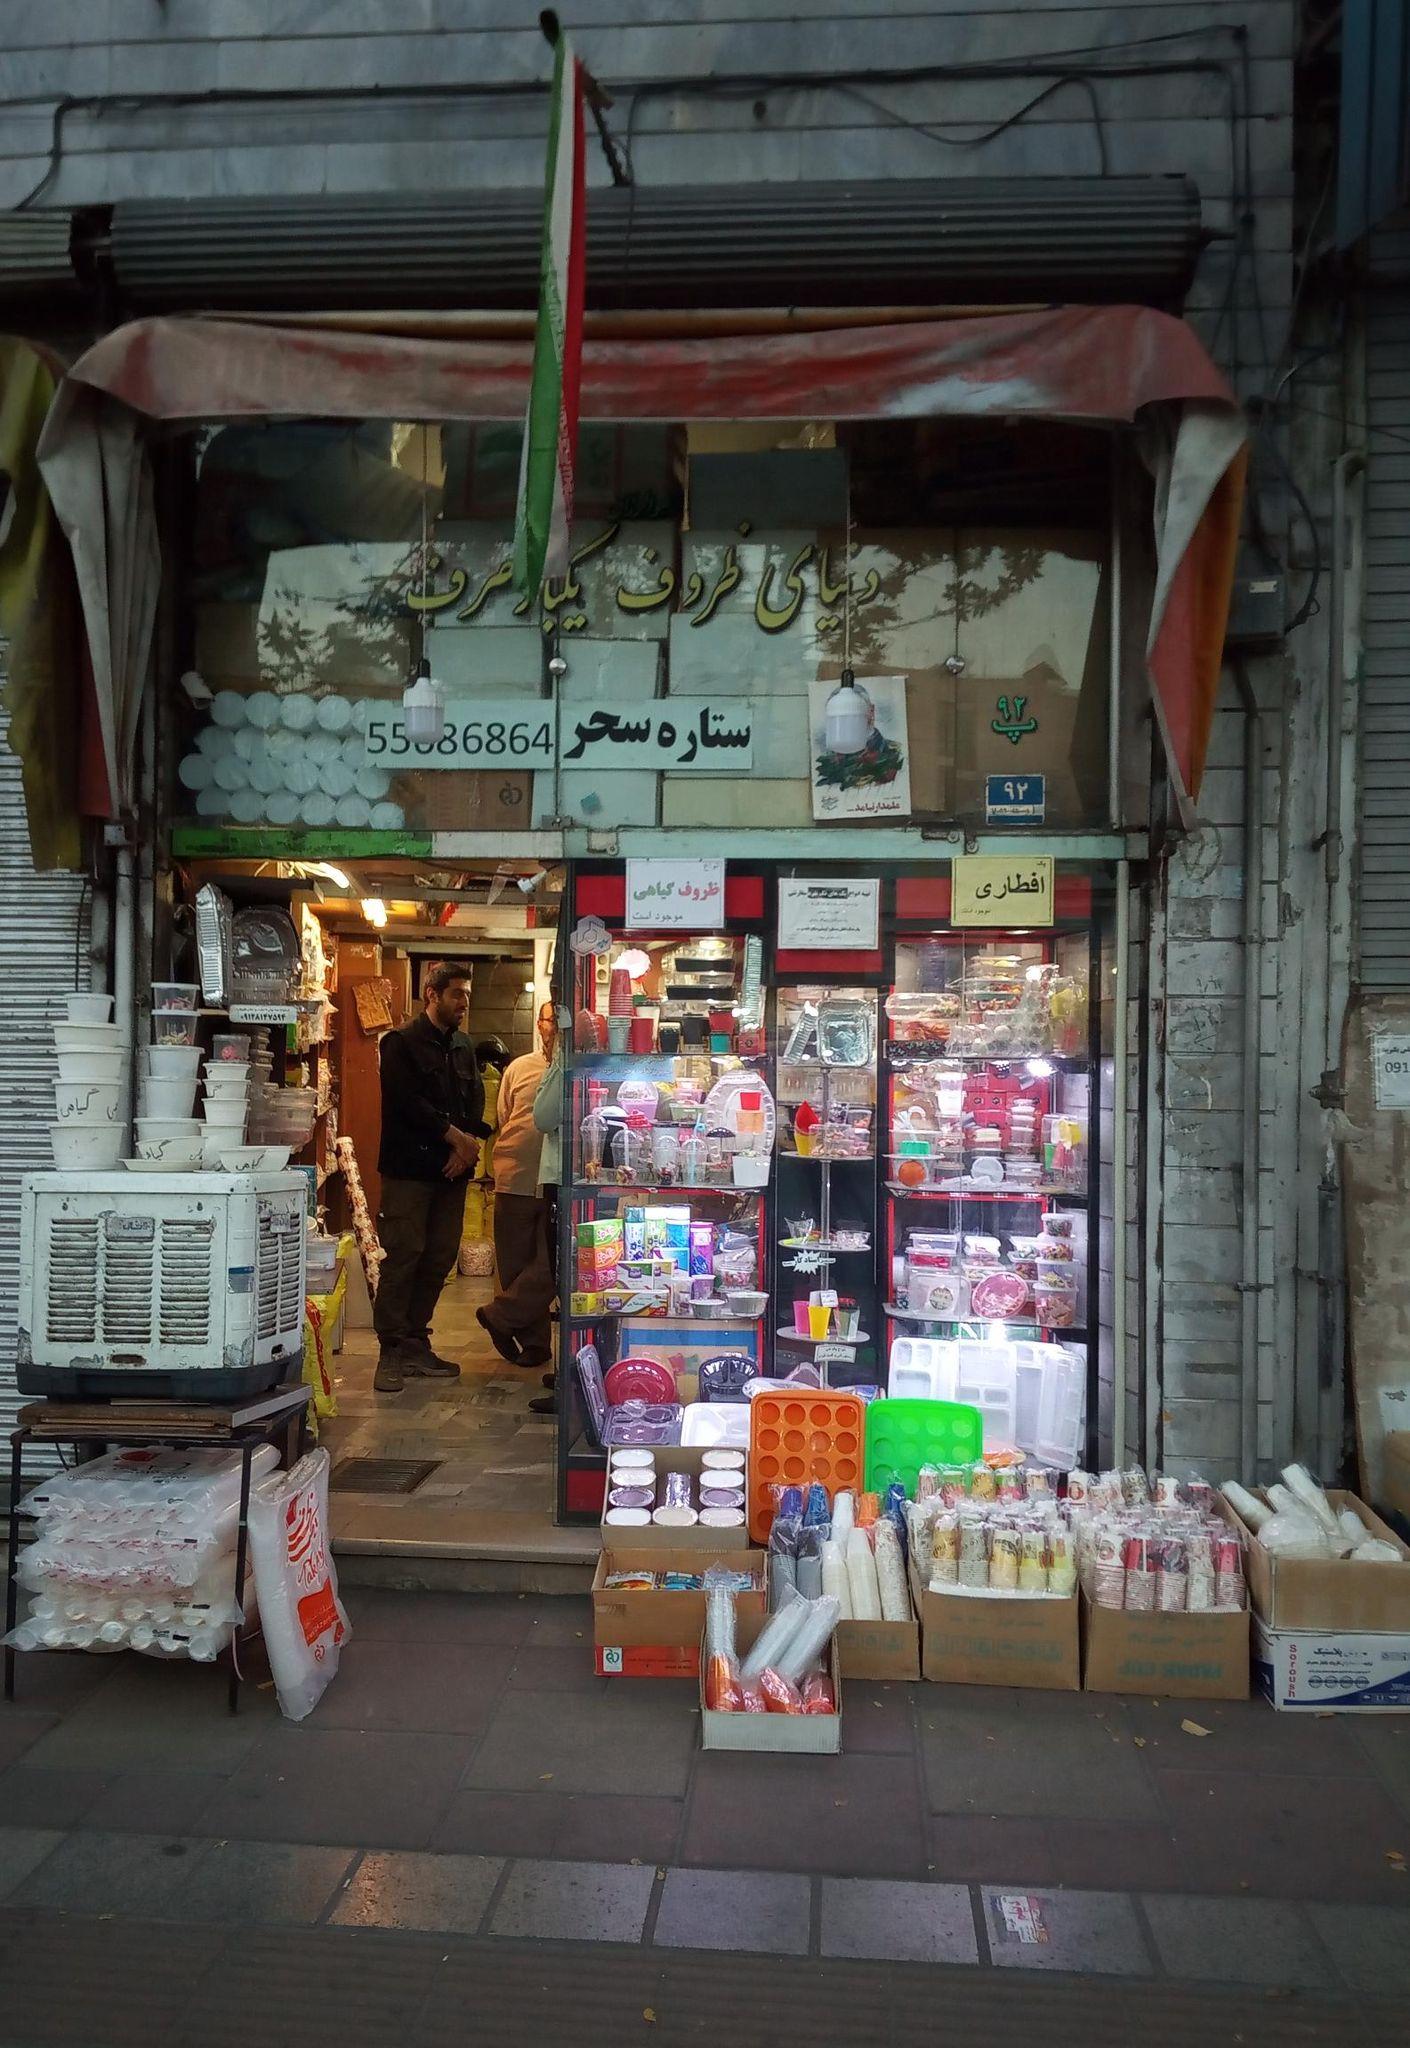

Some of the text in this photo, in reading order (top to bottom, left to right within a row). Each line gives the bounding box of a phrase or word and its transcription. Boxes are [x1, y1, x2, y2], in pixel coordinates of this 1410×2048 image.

[406, 556, 514, 621] صرف
[617, 522, 750, 628] ظروف
[756, 542, 879, 634] دنیای
[367, 706, 750, 762] ستاره سحر 5586864
[991, 717, 1038, 745] پ
[1004, 781, 1029, 800] ۹۲
[633, 881, 720, 901] ظروف گیاهی
[975, 871, 1045, 900] افطاری
[1288, 1644, 1298, 1698] Soroush
